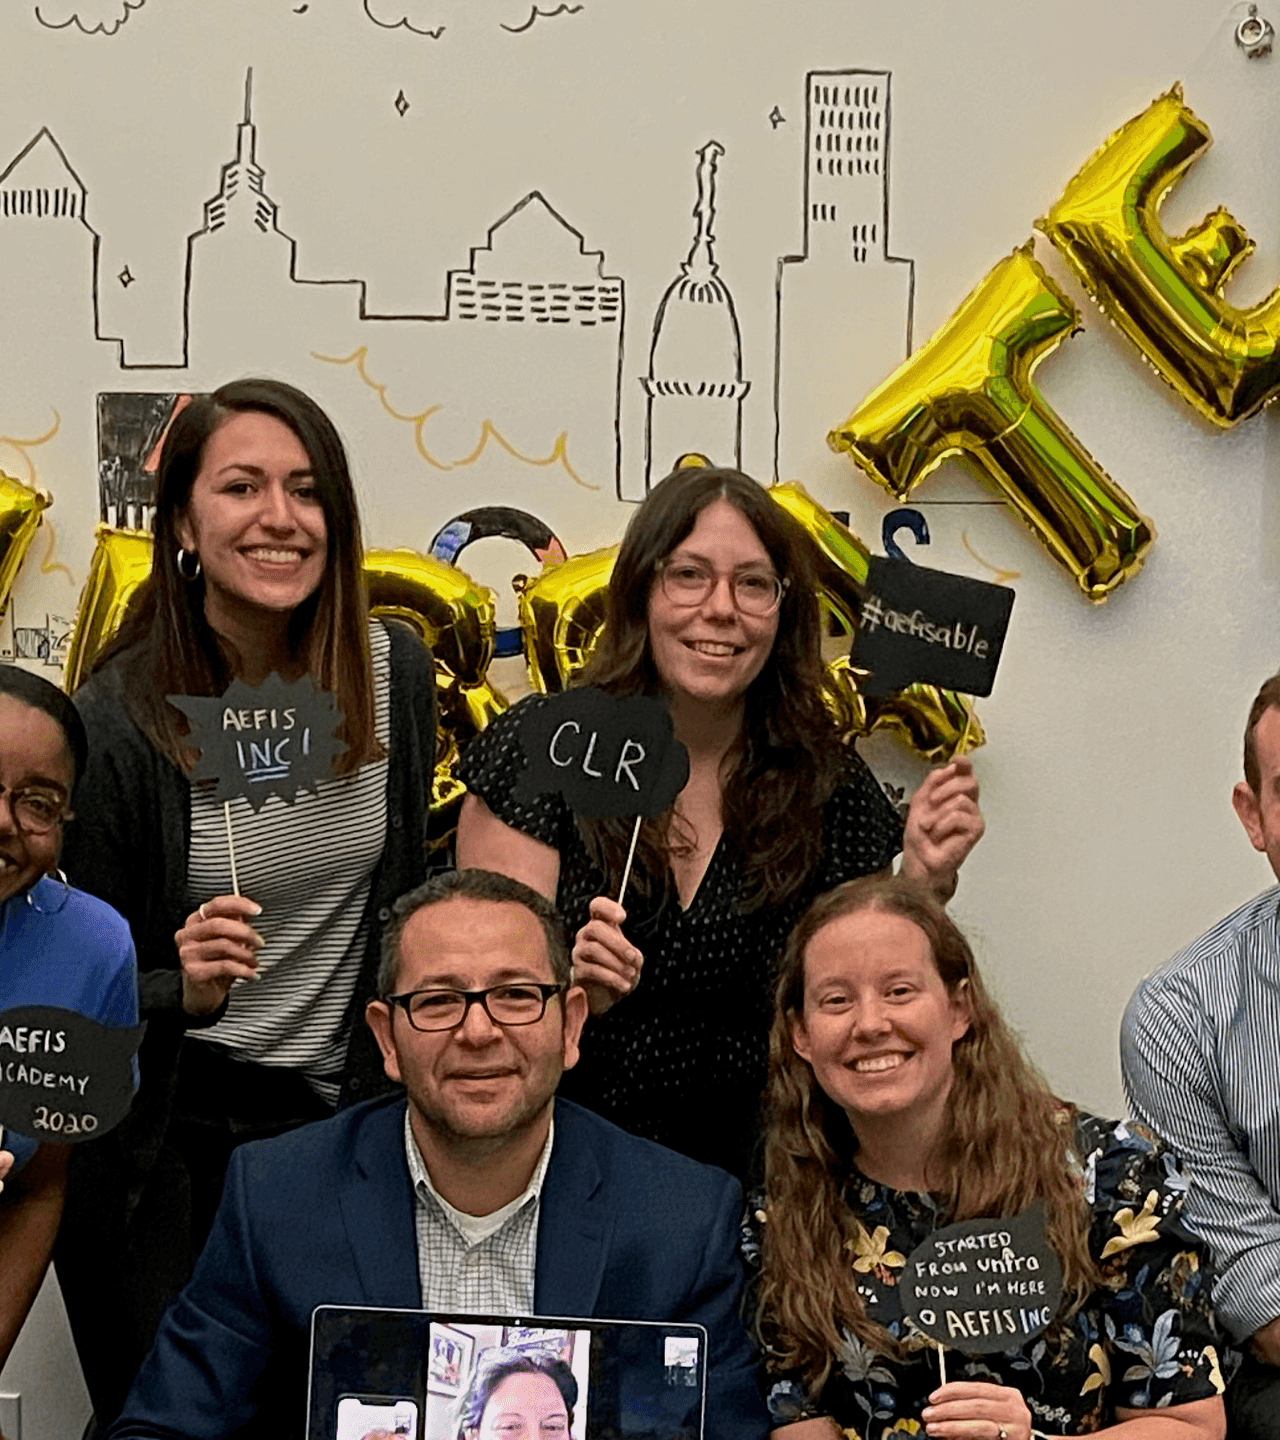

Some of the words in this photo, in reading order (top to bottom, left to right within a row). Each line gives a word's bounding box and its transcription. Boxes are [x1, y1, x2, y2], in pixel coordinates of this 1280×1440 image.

[860, 595, 989, 659] #aefisable
[223, 706, 297, 731] AEFIS
[549, 721, 646, 791] CLR
[32, 1106, 98, 1134] 2020
[934, 1231, 1011, 1258] STARTED
[915, 1261, 968, 1278] FROM
[915, 1285, 959, 1298] NOW
[975, 1280, 1001, 1295] I'M
[1007, 1280, 1046, 1296] HERE
[945, 1307, 1017, 1338] AEFIS
[1020, 1306, 1051, 1334] INC
